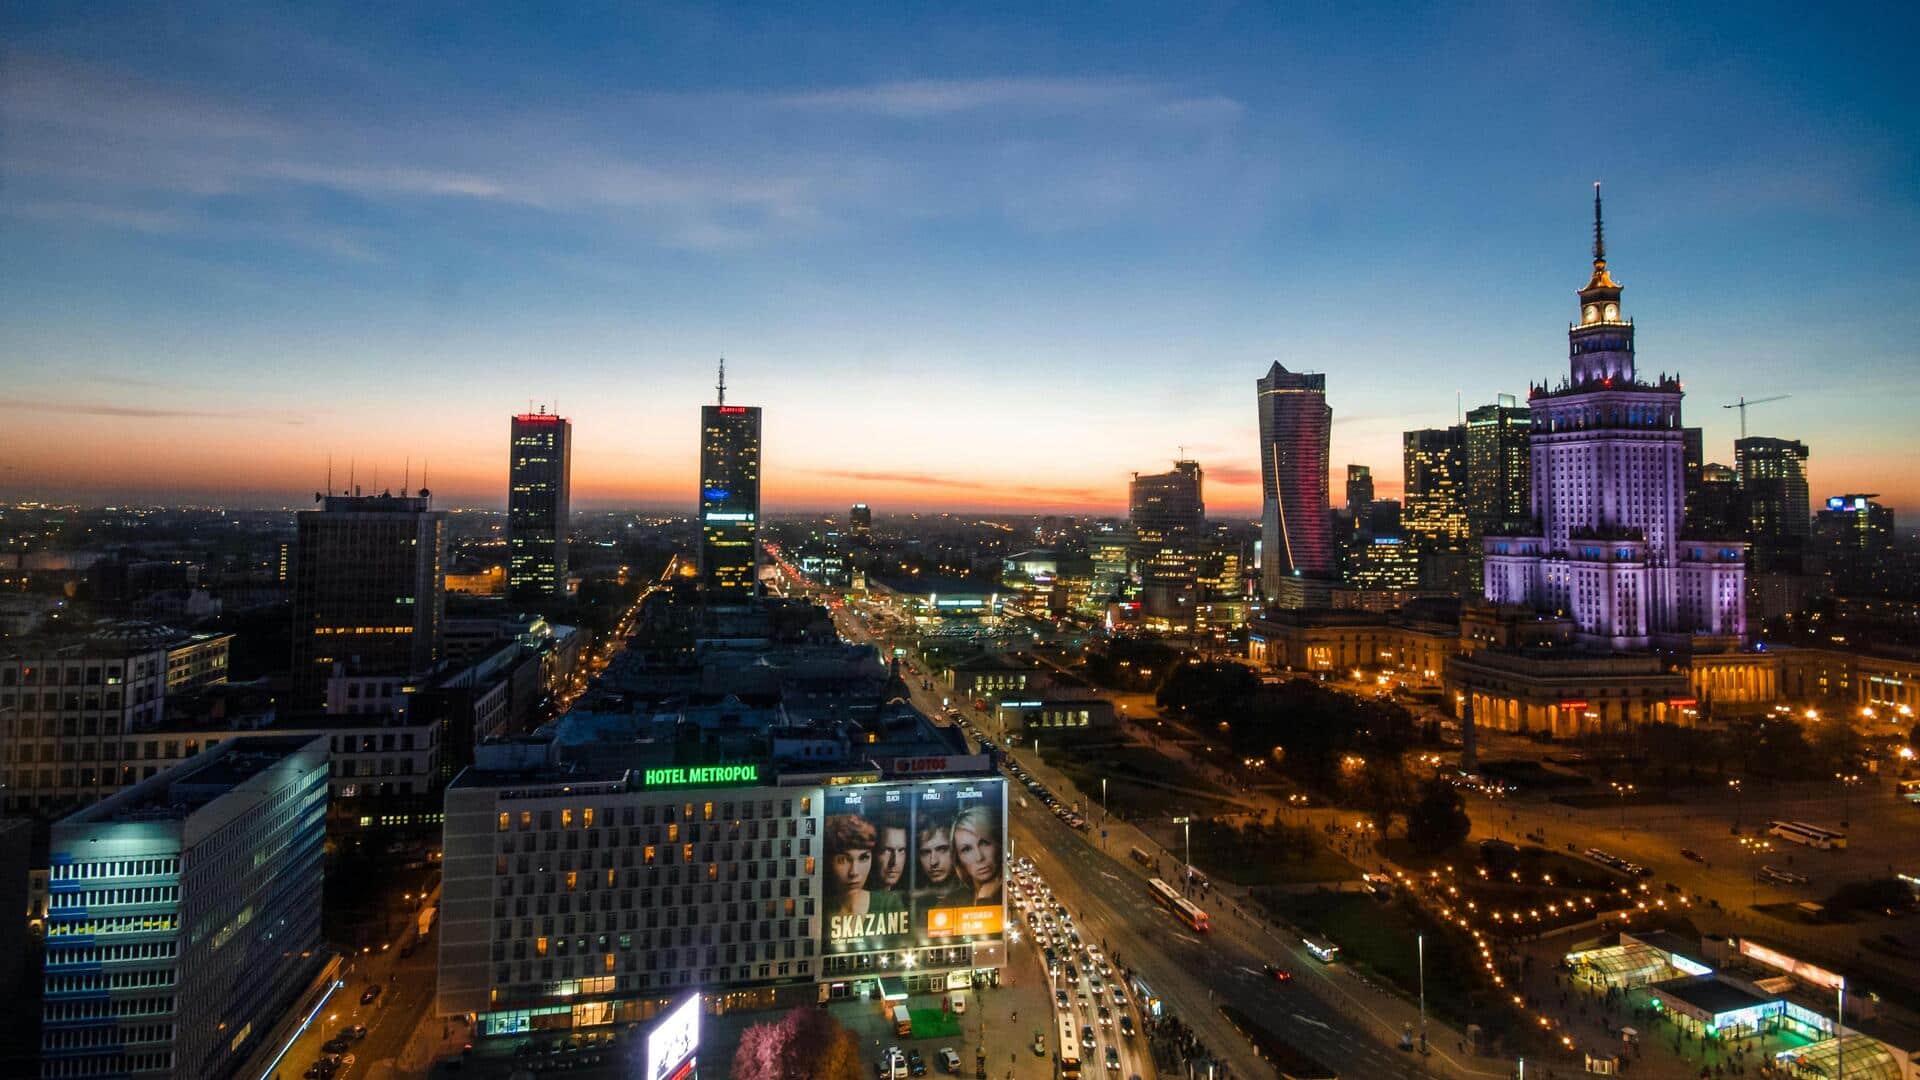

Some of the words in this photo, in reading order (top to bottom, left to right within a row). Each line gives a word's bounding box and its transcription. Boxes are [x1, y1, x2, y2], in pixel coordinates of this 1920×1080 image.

[646, 768, 687, 784] HOTEL
[689, 765, 758, 783] METROPOL
[912, 759, 946, 771] LOTOS
[831, 911, 909, 938] SKAZANE
